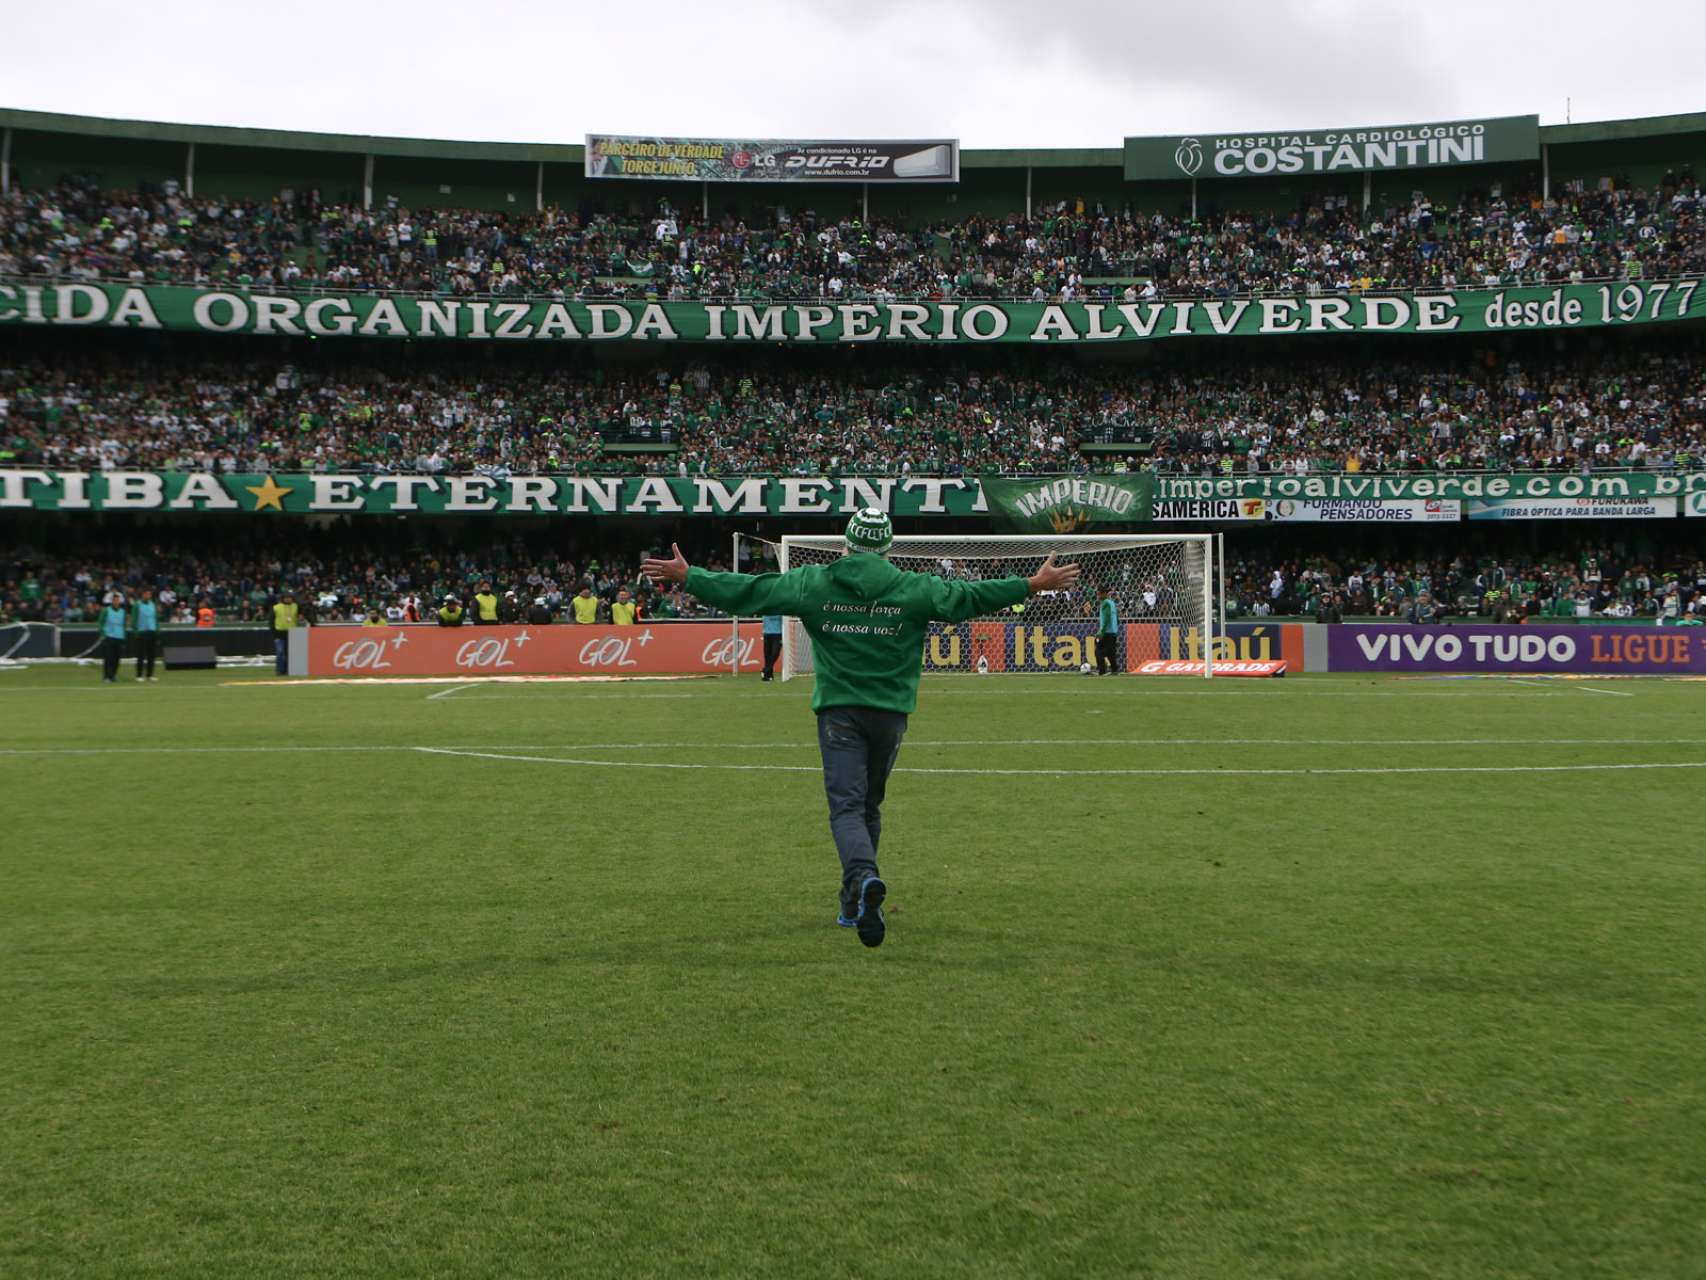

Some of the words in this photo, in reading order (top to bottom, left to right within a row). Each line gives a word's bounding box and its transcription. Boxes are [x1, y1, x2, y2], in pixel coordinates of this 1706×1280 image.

[1215, 136, 1316, 149] HOSPITAL
[1325, 125, 1485, 145] CARDIOLÓGICO
[674, 144, 725, 159] VERDADE
[1213, 135, 1485, 175] COSTANTINI
[754, 154, 776, 167] LG
[784, 156, 890, 168] DUFRIO
[804, 168, 870, 176] www.dufrio.com.br
[193, 291, 679, 340] ORGANIZADA
[1030, 293, 1462, 342] ALVIVERDE
[1484, 288, 1583, 328] desde
[1598, 280, 1699, 324] 1977
[1319, 508, 1413, 520] PENSADORES
[1502, 508, 1528, 517] FIBRA
[1565, 507, 1590, 516] PARA
[1592, 507, 1623, 516] BANDA
[1626, 507, 1656, 515] LARGA
[833, 604, 867, 612] nossa
[869, 600, 902, 618] força
[832, 624, 869, 634] nossa
[873, 622, 903, 636] voz!
[1169, 626, 1271, 661] Itaú
[1356, 633, 1463, 662] VIVO
[1468, 634, 1577, 663] TUDO
[1590, 634, 1691, 663] LIGUE
